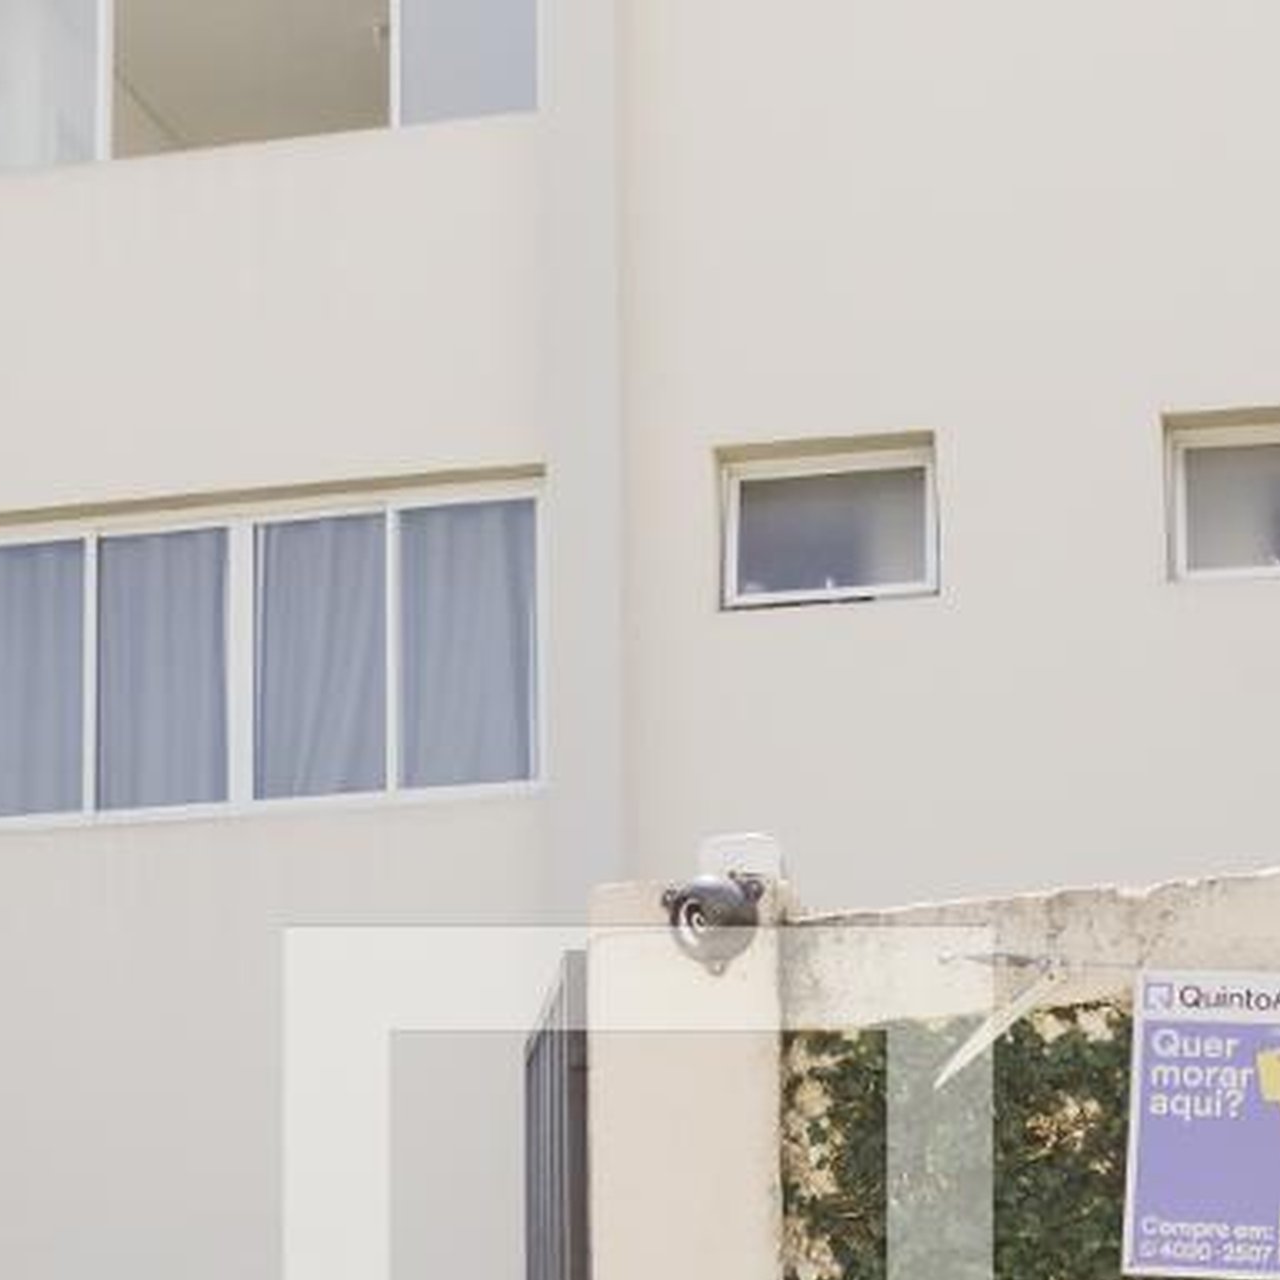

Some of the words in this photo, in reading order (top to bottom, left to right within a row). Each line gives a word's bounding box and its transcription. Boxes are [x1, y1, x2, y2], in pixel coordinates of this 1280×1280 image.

[1152, 1030, 1239, 1057] Quer
[1151, 1064, 1254, 1088] morar
[1150, 1090, 1244, 1121] aqui?
[1142, 1217, 1230, 1241] Compre
